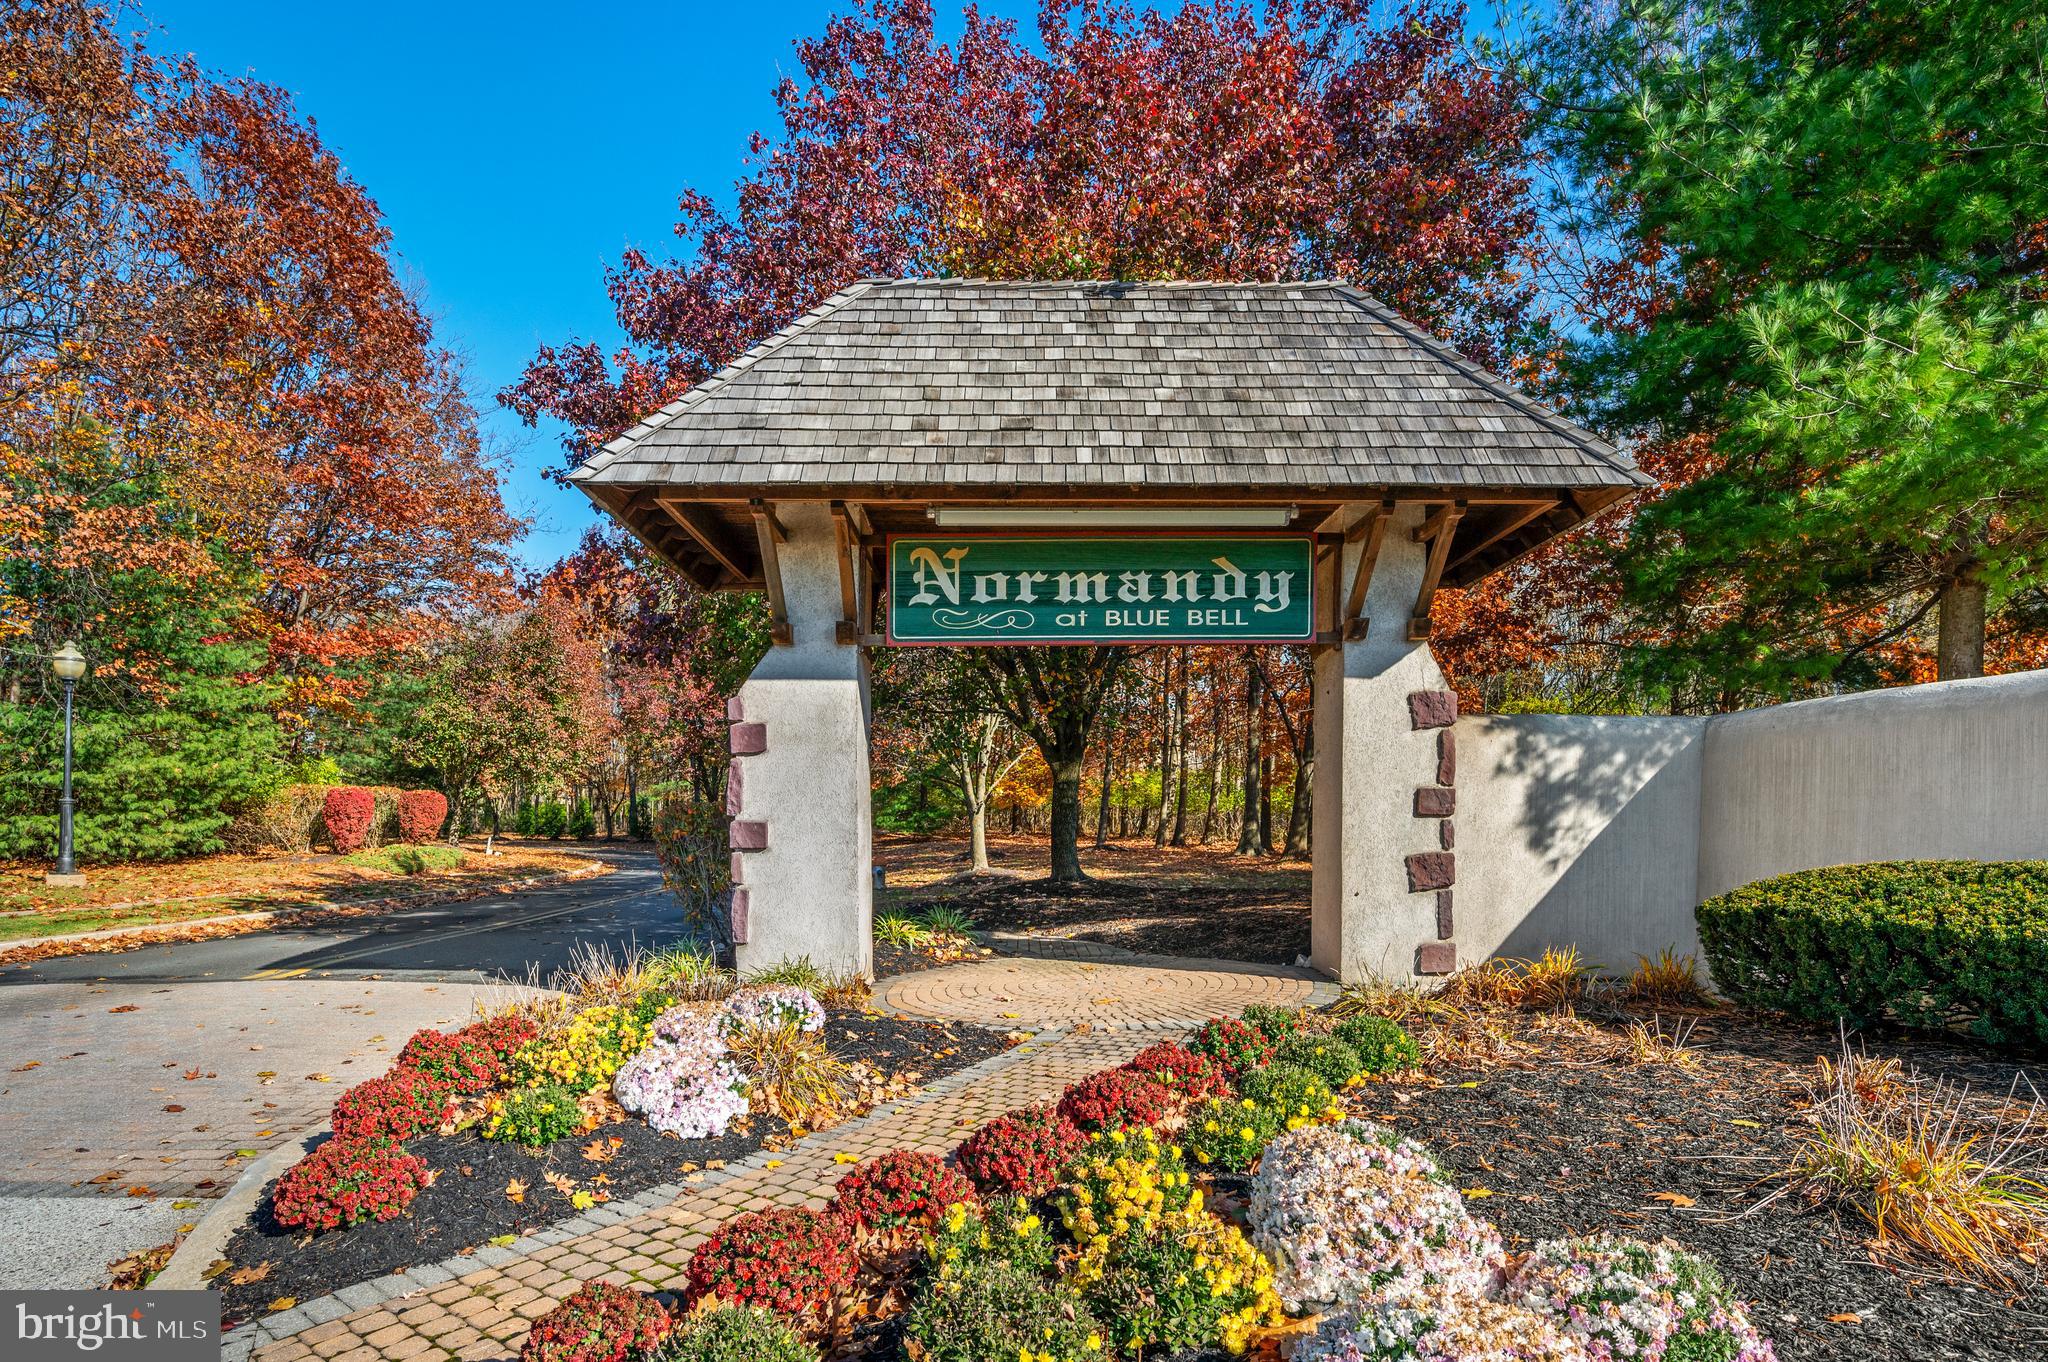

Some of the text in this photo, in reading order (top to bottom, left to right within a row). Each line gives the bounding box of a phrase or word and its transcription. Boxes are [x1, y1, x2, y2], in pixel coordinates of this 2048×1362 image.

[908, 546, 1295, 613] Normandy
[1055, 609, 1249, 627] at BLUE BELL
